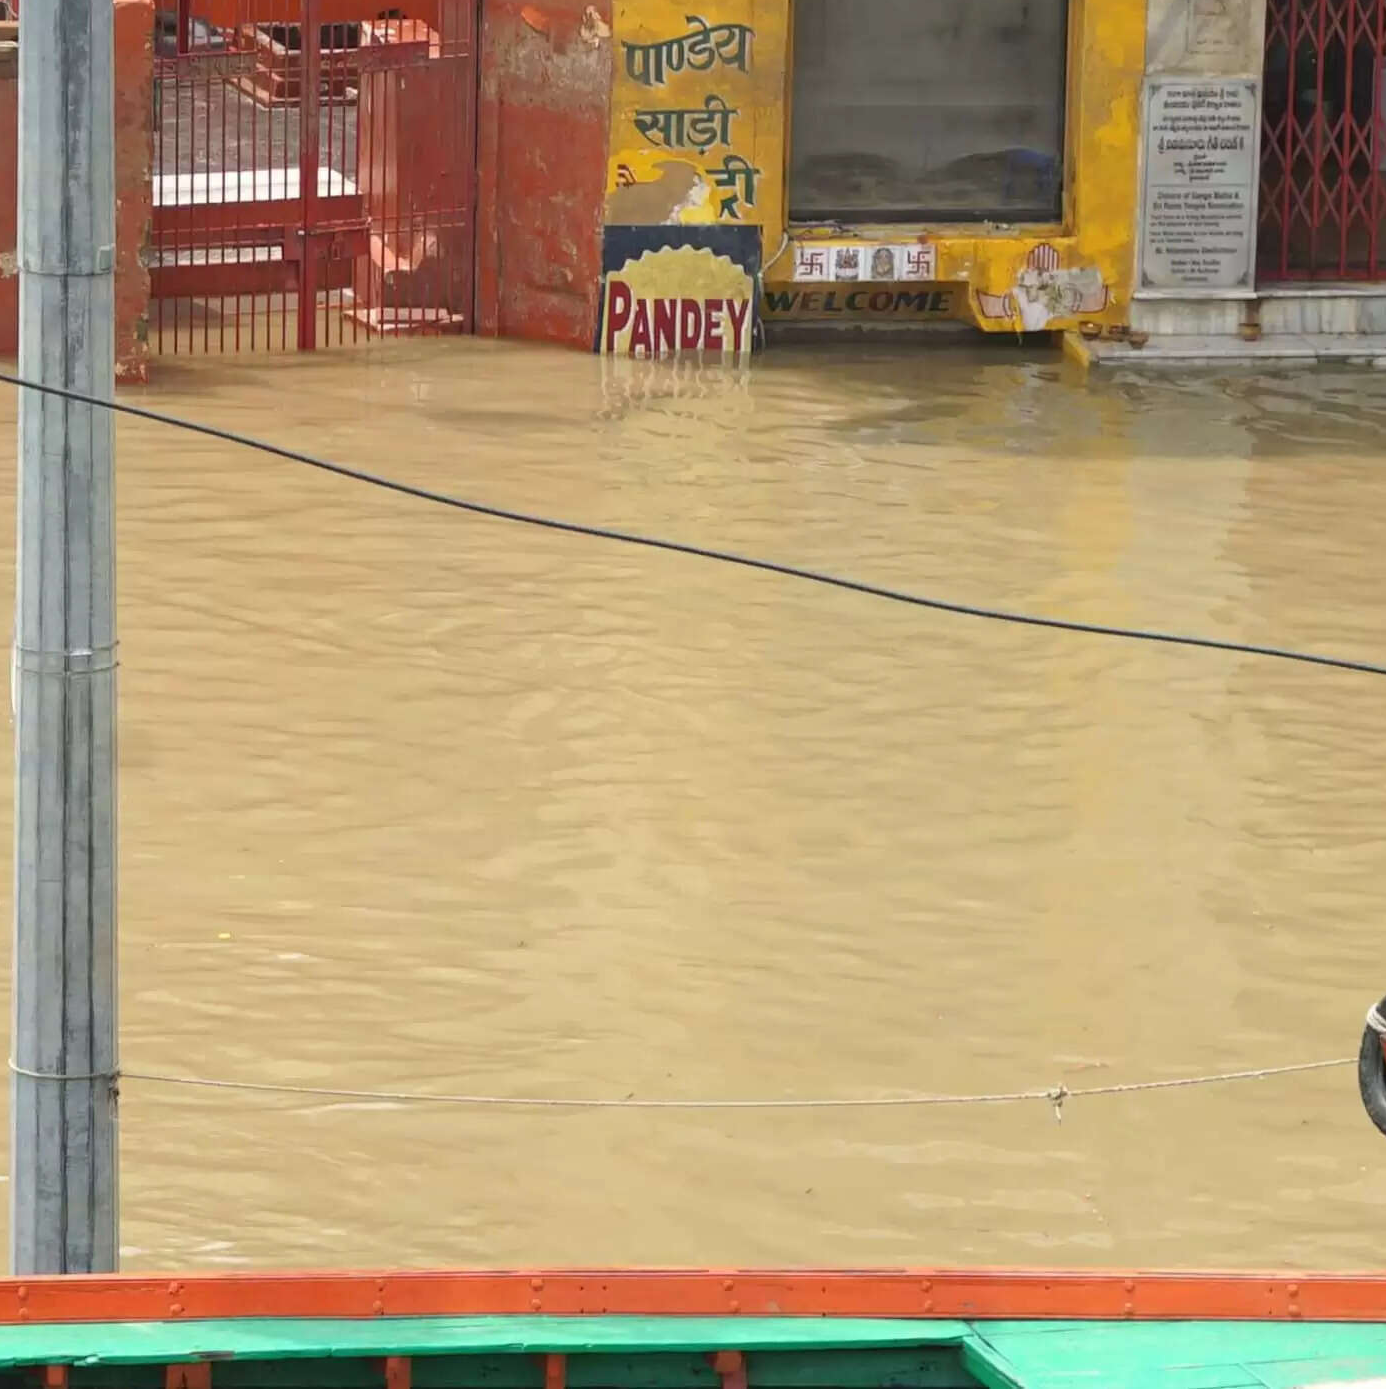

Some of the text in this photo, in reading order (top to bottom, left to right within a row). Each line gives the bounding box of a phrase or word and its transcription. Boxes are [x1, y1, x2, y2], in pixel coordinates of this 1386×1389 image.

[623, 14, 756, 88] पाण्डेय
[634, 94, 739, 156] साड़ी
[607, 280, 751, 356] PANDEY
[765, 289, 955, 313] WELCOME
